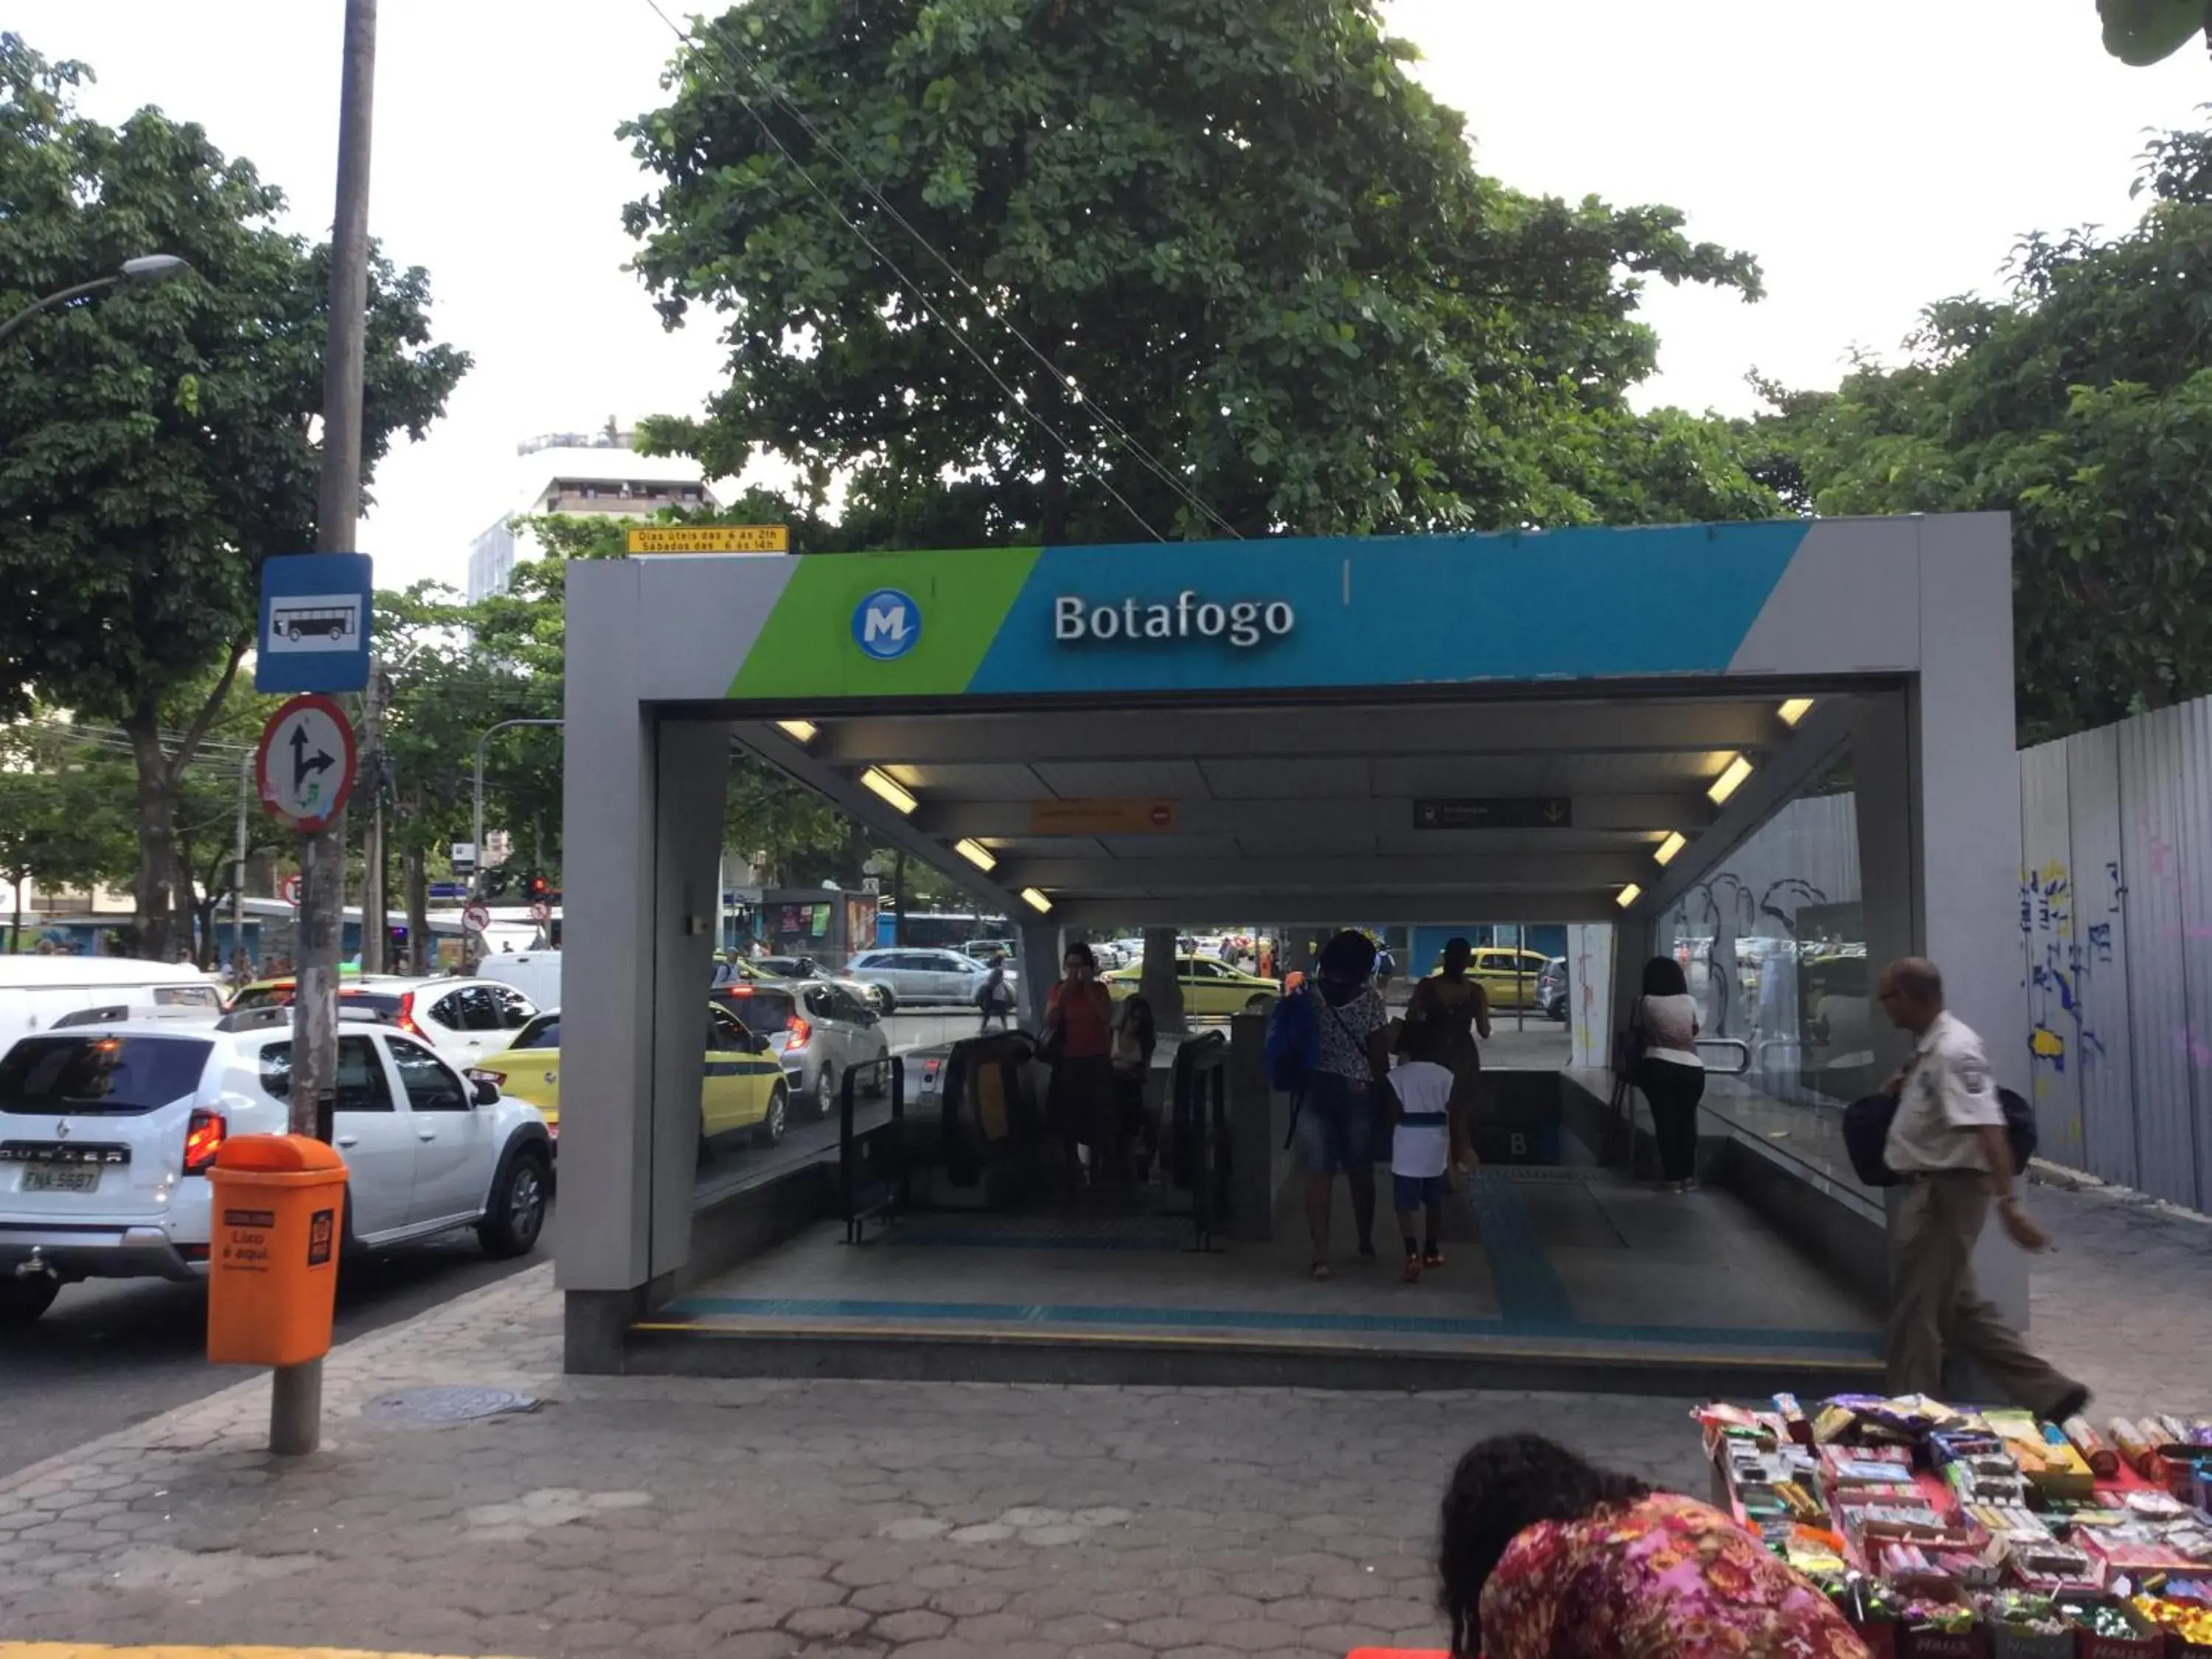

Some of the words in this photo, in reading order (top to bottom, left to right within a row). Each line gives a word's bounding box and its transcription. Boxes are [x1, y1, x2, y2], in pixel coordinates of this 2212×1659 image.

[639, 532, 663, 540] Dias
[701, 530, 721, 540] das
[758, 529, 776, 539] 21h
[694, 541, 714, 550] das
[724, 540, 732, 549] 6
[754, 540, 773, 549] 14h
[864, 606, 915, 641] M
[1054, 591, 1295, 647] Botafogo
[1510, 1133, 1527, 1155] B
[232, 1230, 264, 1245] Lixo
